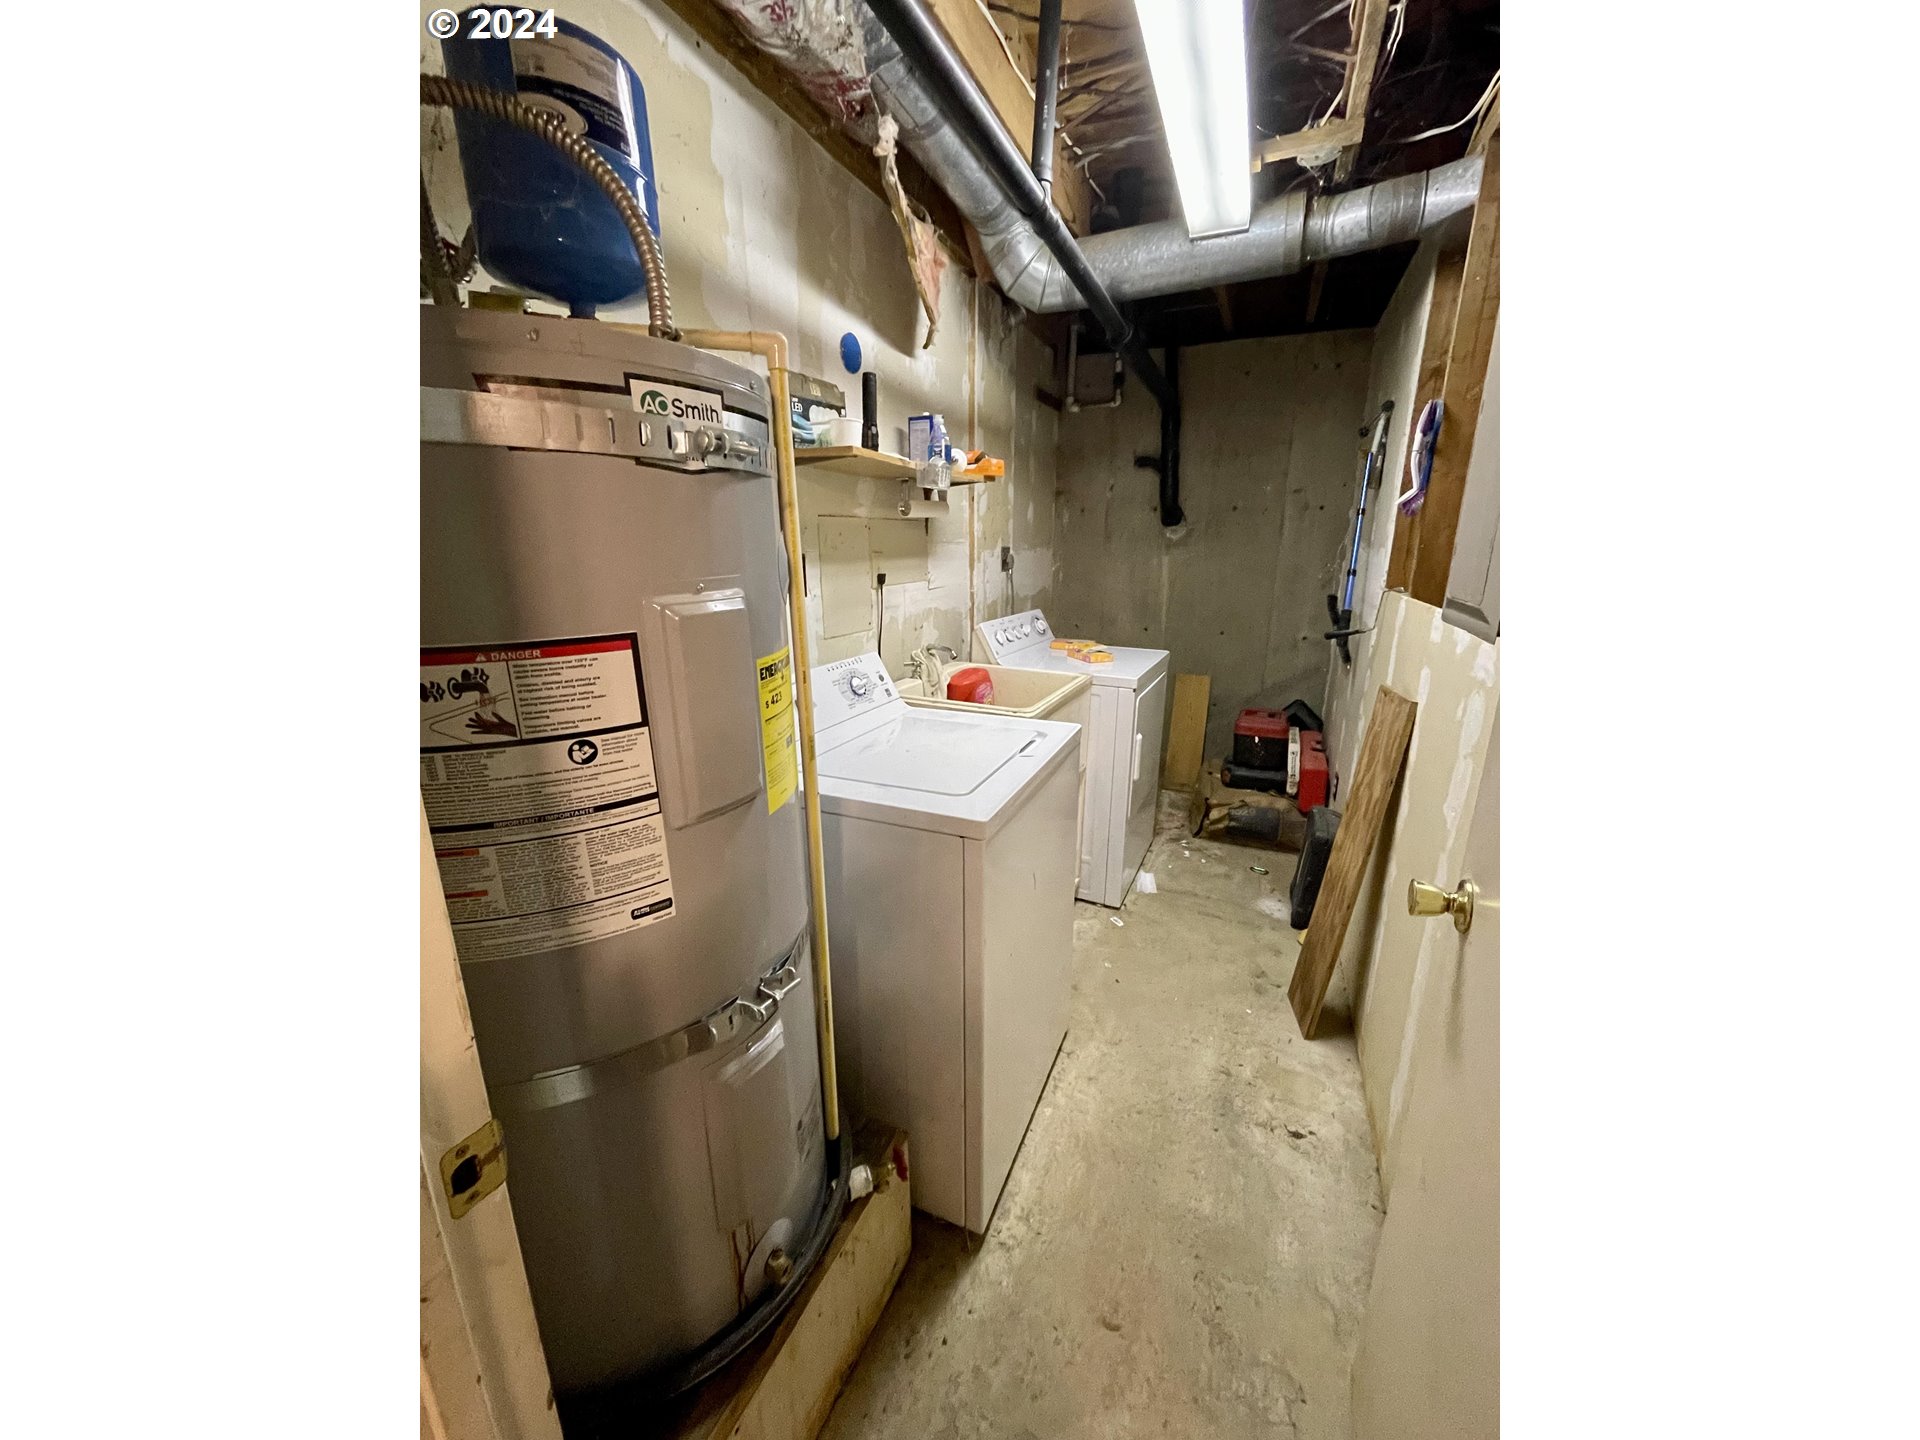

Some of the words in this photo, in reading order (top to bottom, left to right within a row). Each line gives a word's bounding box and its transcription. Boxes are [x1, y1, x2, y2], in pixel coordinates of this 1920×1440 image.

[671, 398, 719, 424] Smith
[791, 401, 803, 413] LED
[491, 649, 541, 661] DANGER
[771, 690, 783, 705] 423
[494, 817, 540, 829] IMPORTANT
[545, 807, 594, 821] IMPORTANTE
